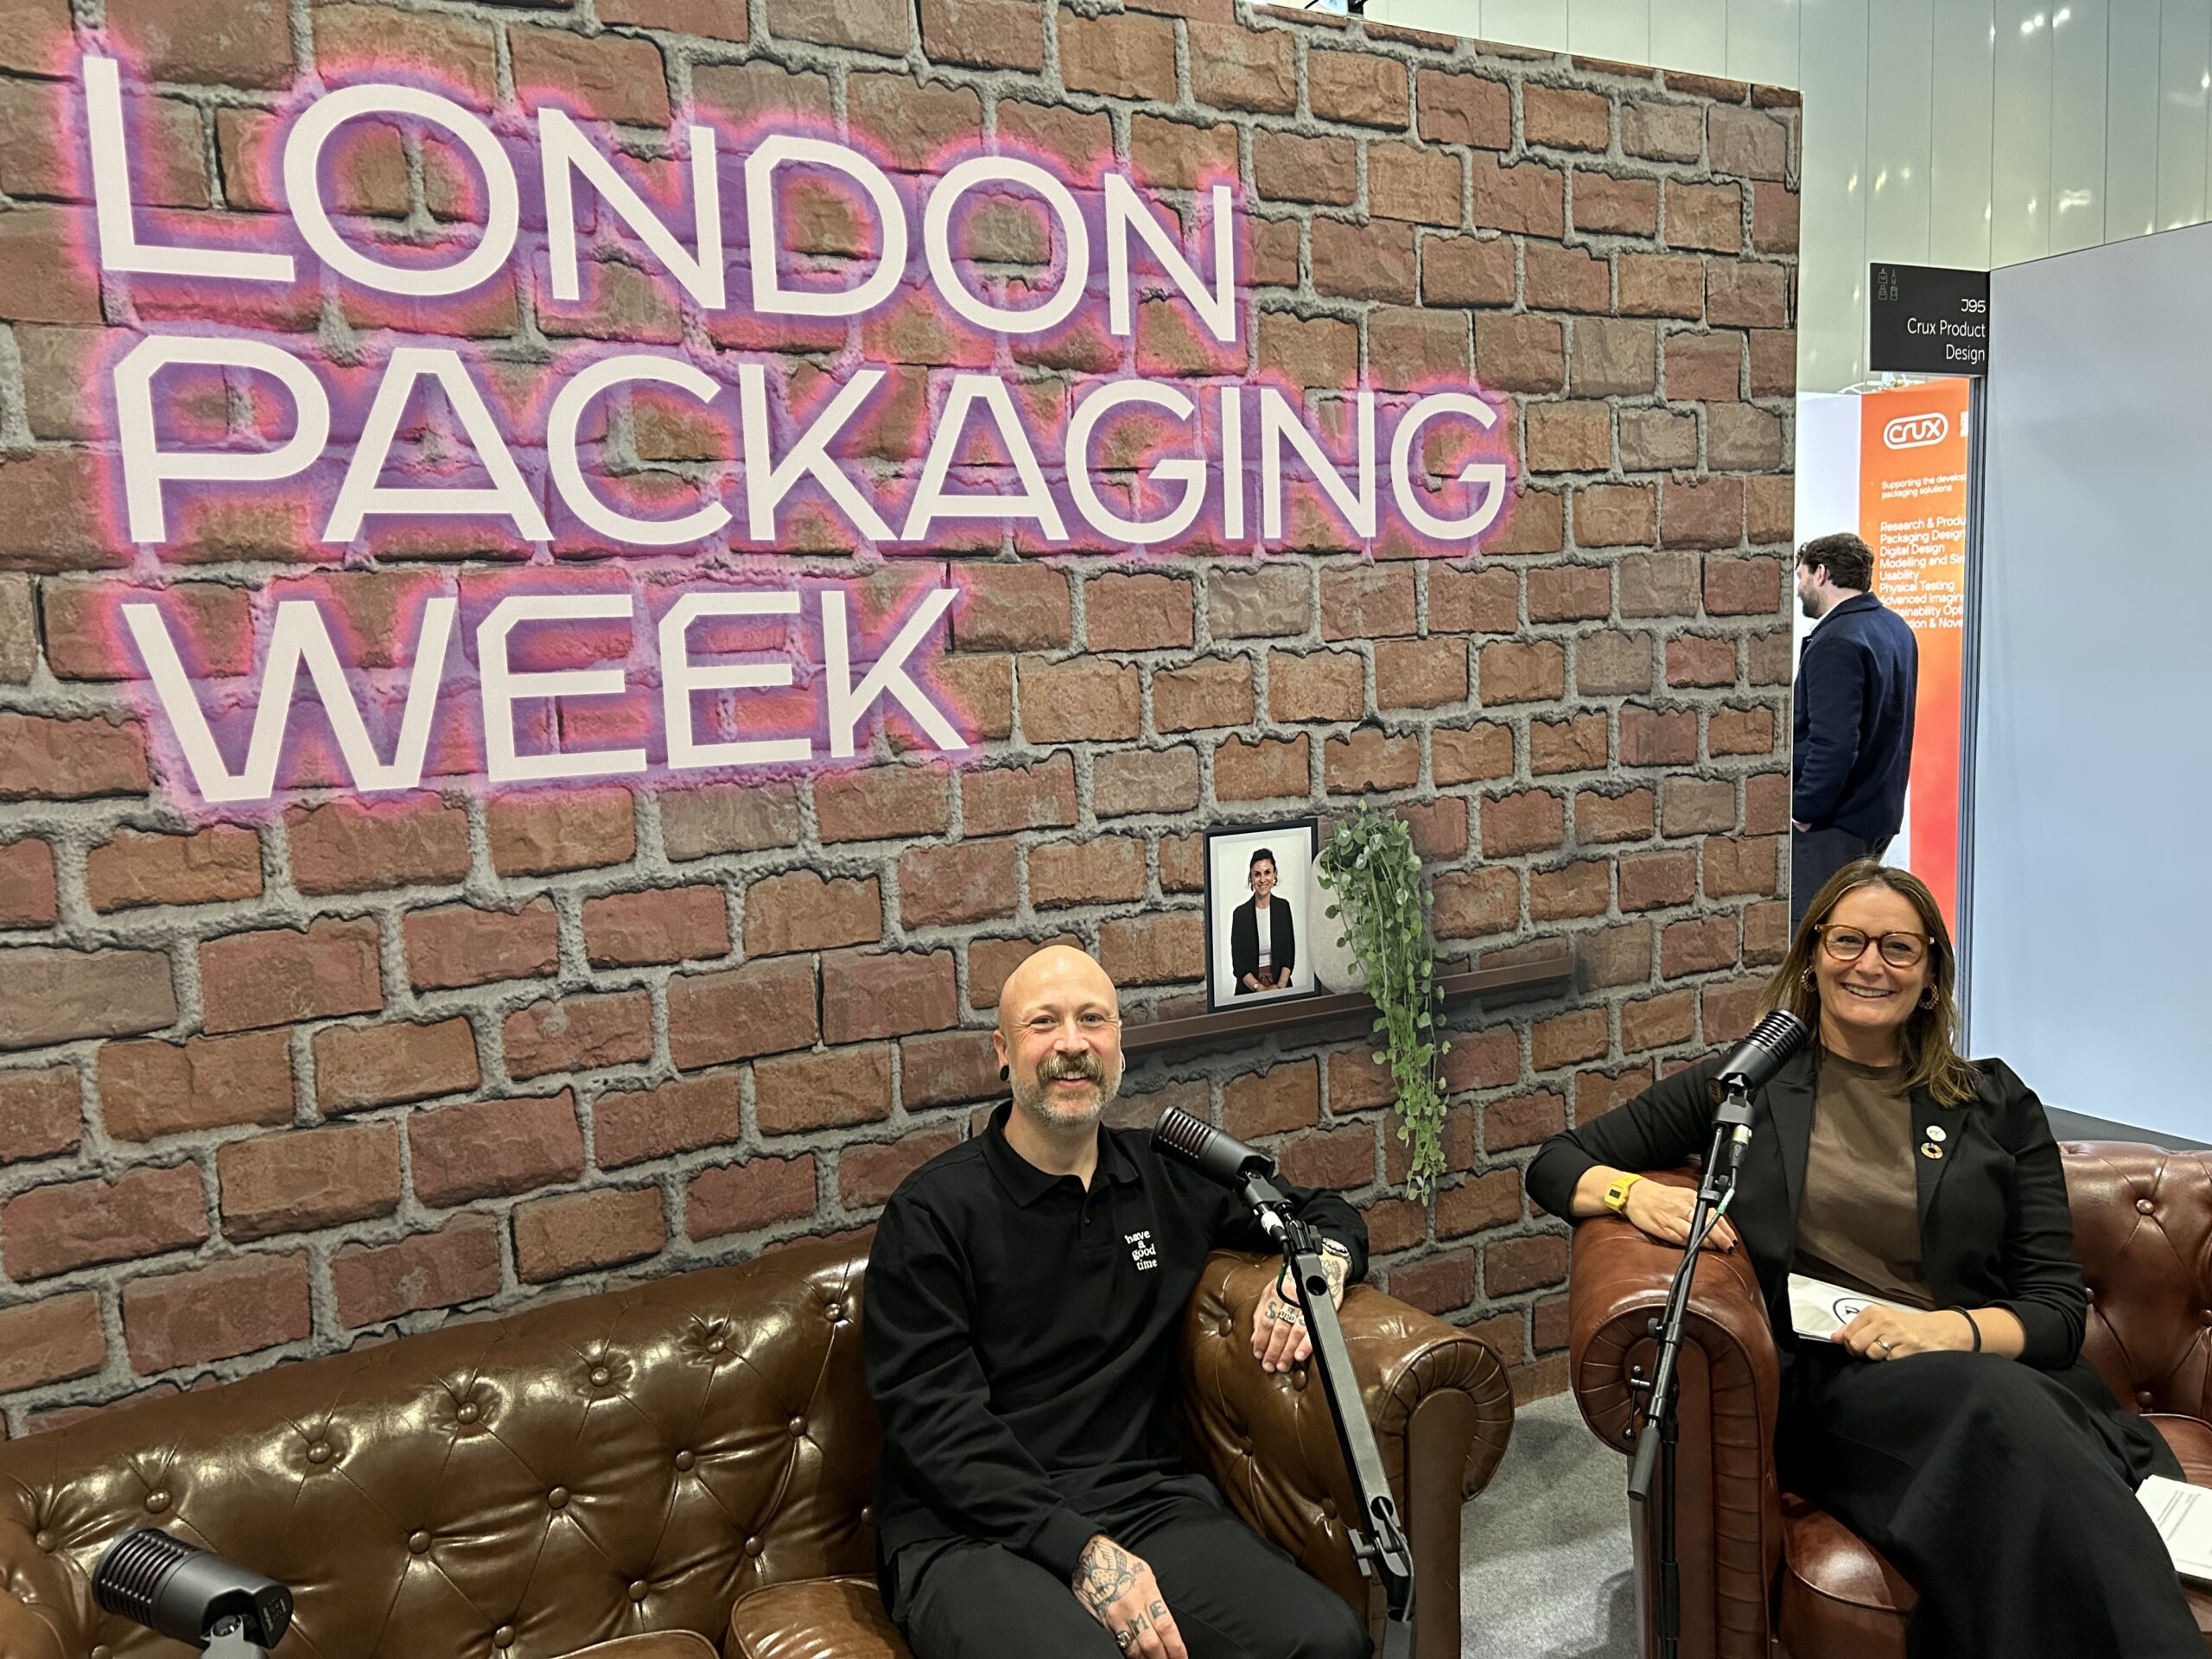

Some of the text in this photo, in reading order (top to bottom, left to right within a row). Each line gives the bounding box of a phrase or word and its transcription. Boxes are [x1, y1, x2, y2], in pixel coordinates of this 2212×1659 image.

[82, 55, 1236, 342] LONDON
[1961, 298, 1986, 314] J95
[1907, 317, 1986, 338] Crux Product
[1946, 343, 1986, 365] Design
[113, 335, 1507, 545] PACKAGING
[1881, 478, 1922, 491] Supporting
[1923, 475, 1936, 485] the
[1880, 484, 1953, 500] packaging solutions
[1880, 519, 1925, 532] Research
[1927, 517, 1935, 528] &
[1880, 531, 1929, 545] Packaging
[1880, 542, 1945, 558] Digital Design
[1879, 557, 1927, 569] Modelling
[1929, 555, 1948, 567] and
[1879, 570, 1920, 582] Usability
[1879, 580, 1955, 595] Physical Testing
[1878, 593, 1927, 605] Advanced
[1929, 618, 1936, 629] &
[121, 588, 969, 804] WEEK
[1124, 1230, 1151, 1244] have
[1137, 1240, 1146, 1249] a
[1132, 1243, 1156, 1262] good
[1136, 1259, 1158, 1271] time
